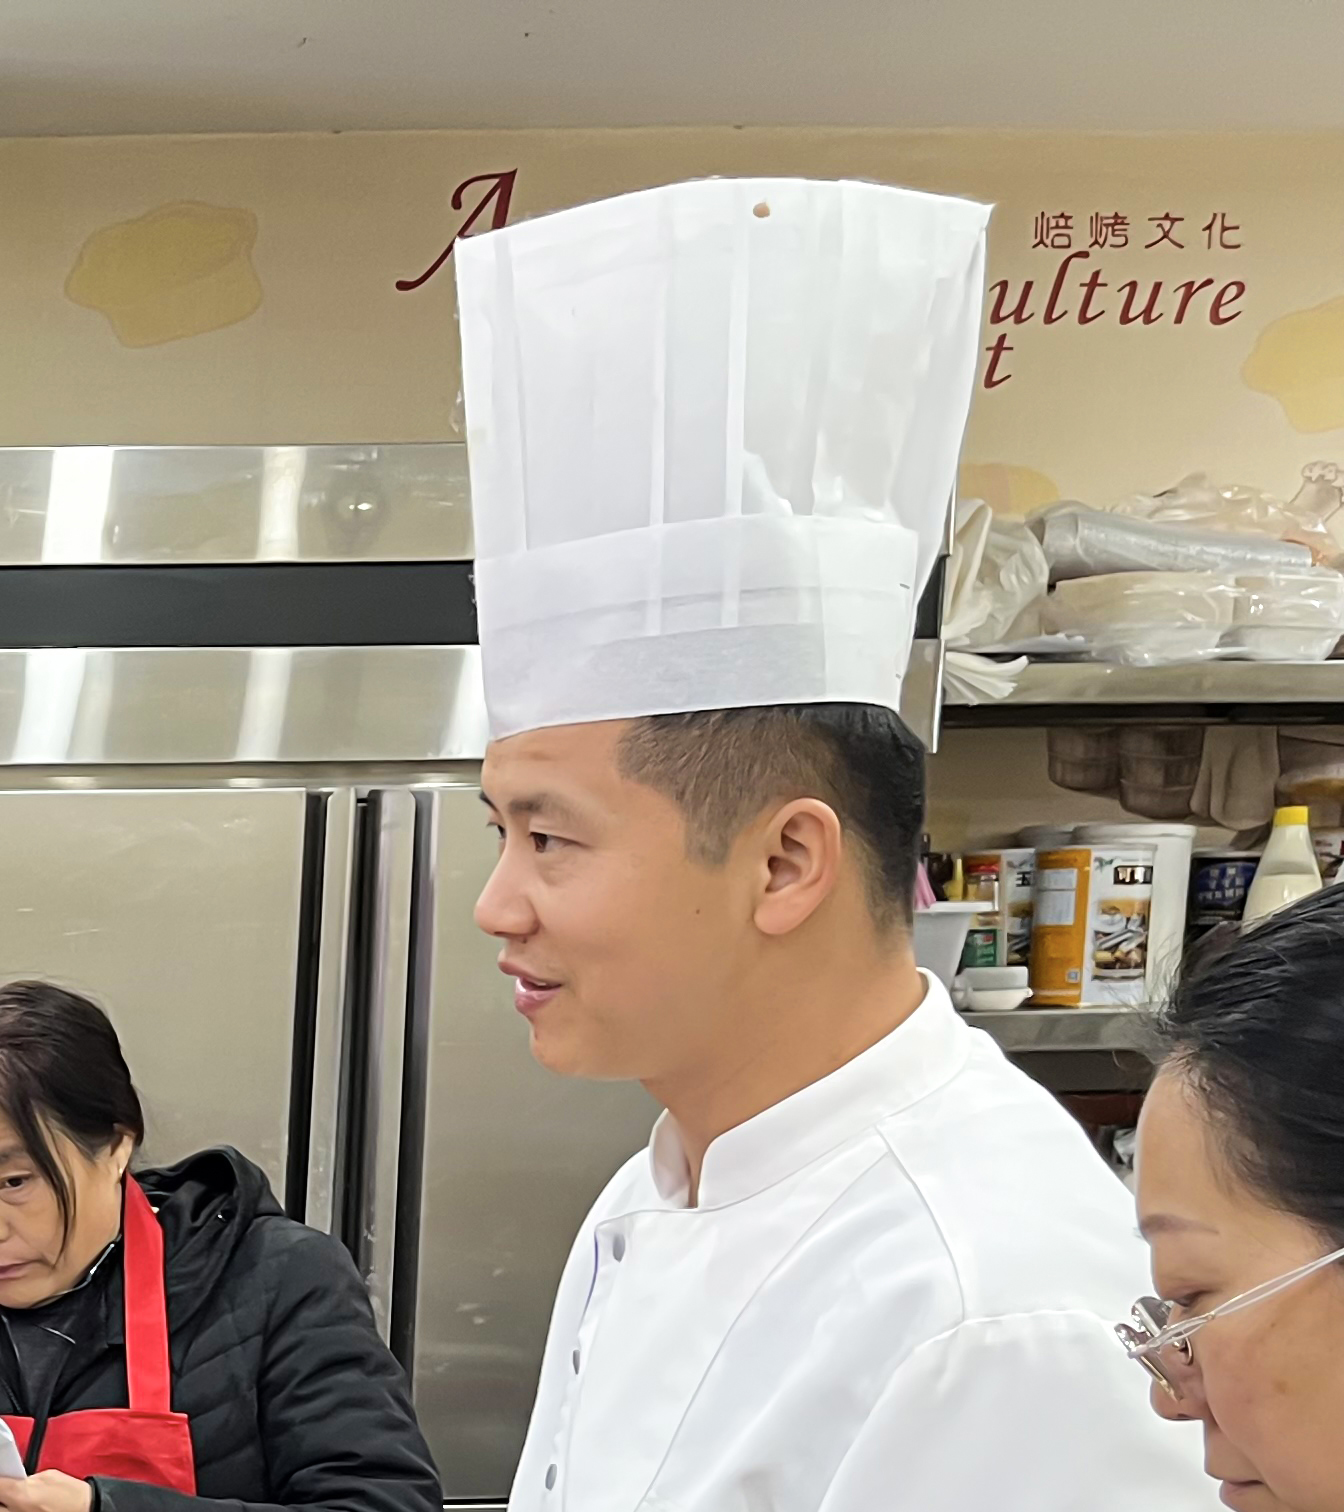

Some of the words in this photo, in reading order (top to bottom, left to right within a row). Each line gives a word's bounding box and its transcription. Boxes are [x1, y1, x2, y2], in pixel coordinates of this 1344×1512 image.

[1031, 211, 1244, 250] 焙烤文化
[986, 250, 1248, 327] ulture
